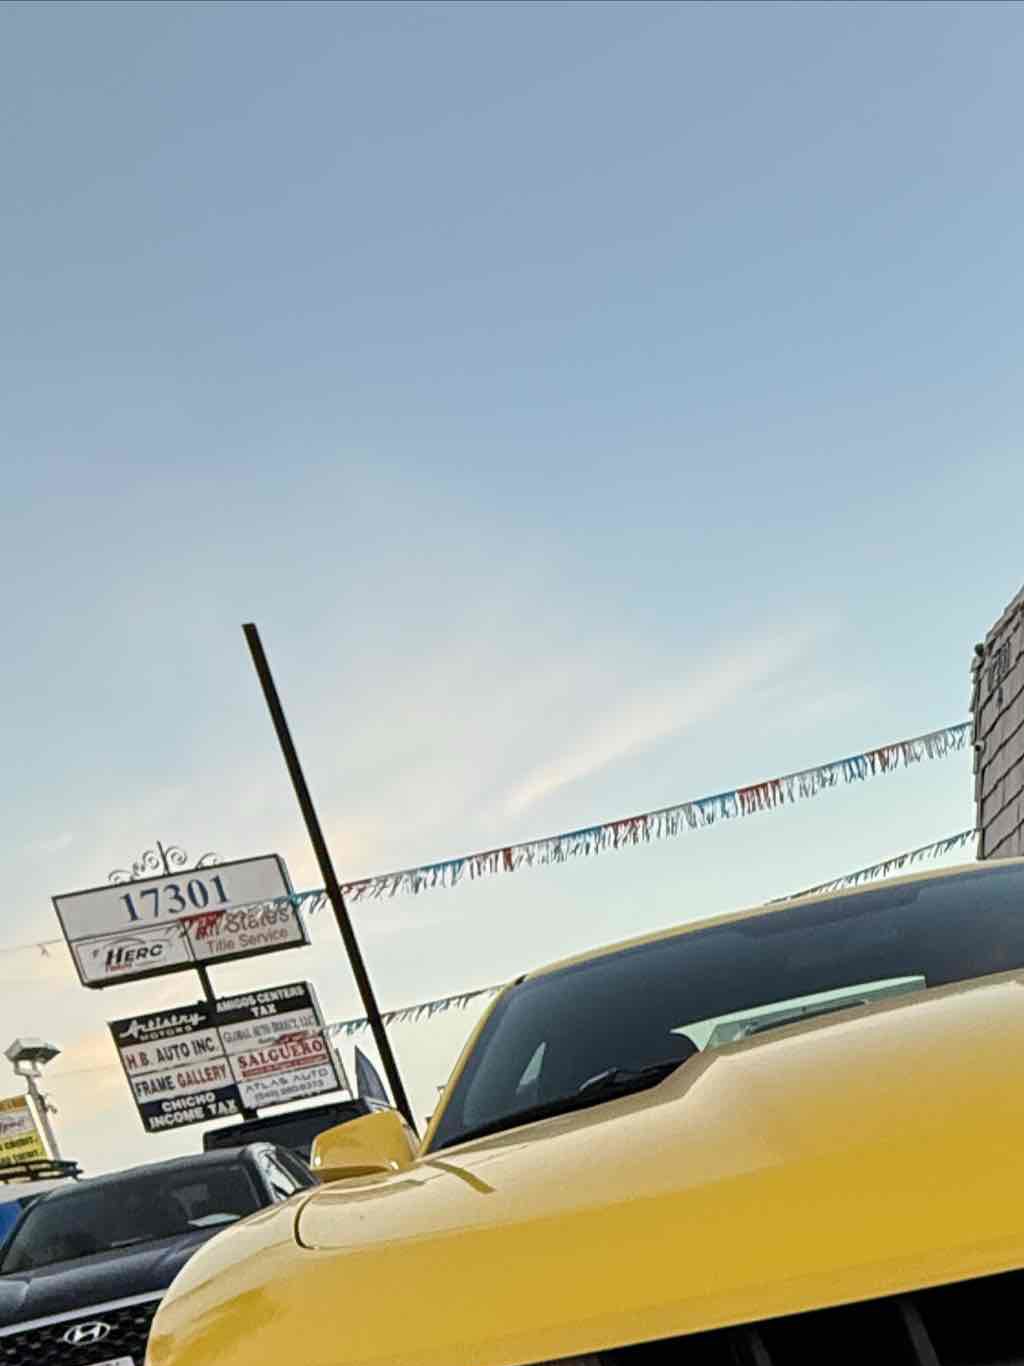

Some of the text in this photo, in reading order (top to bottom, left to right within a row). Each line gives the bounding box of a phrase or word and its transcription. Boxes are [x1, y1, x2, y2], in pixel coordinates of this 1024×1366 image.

[120, 875, 228, 921] 17301
[239, 928, 288, 948] Service
[252, 1003, 277, 1017] TAX
[156, 1043, 190, 1062] AUTO
[135, 1076, 175, 1097] FRAME
[177, 1064, 226, 1088] GALLERY
[293, 1068, 328, 1082] AUTO
[149, 1100, 238, 1129] INCOME TAX
